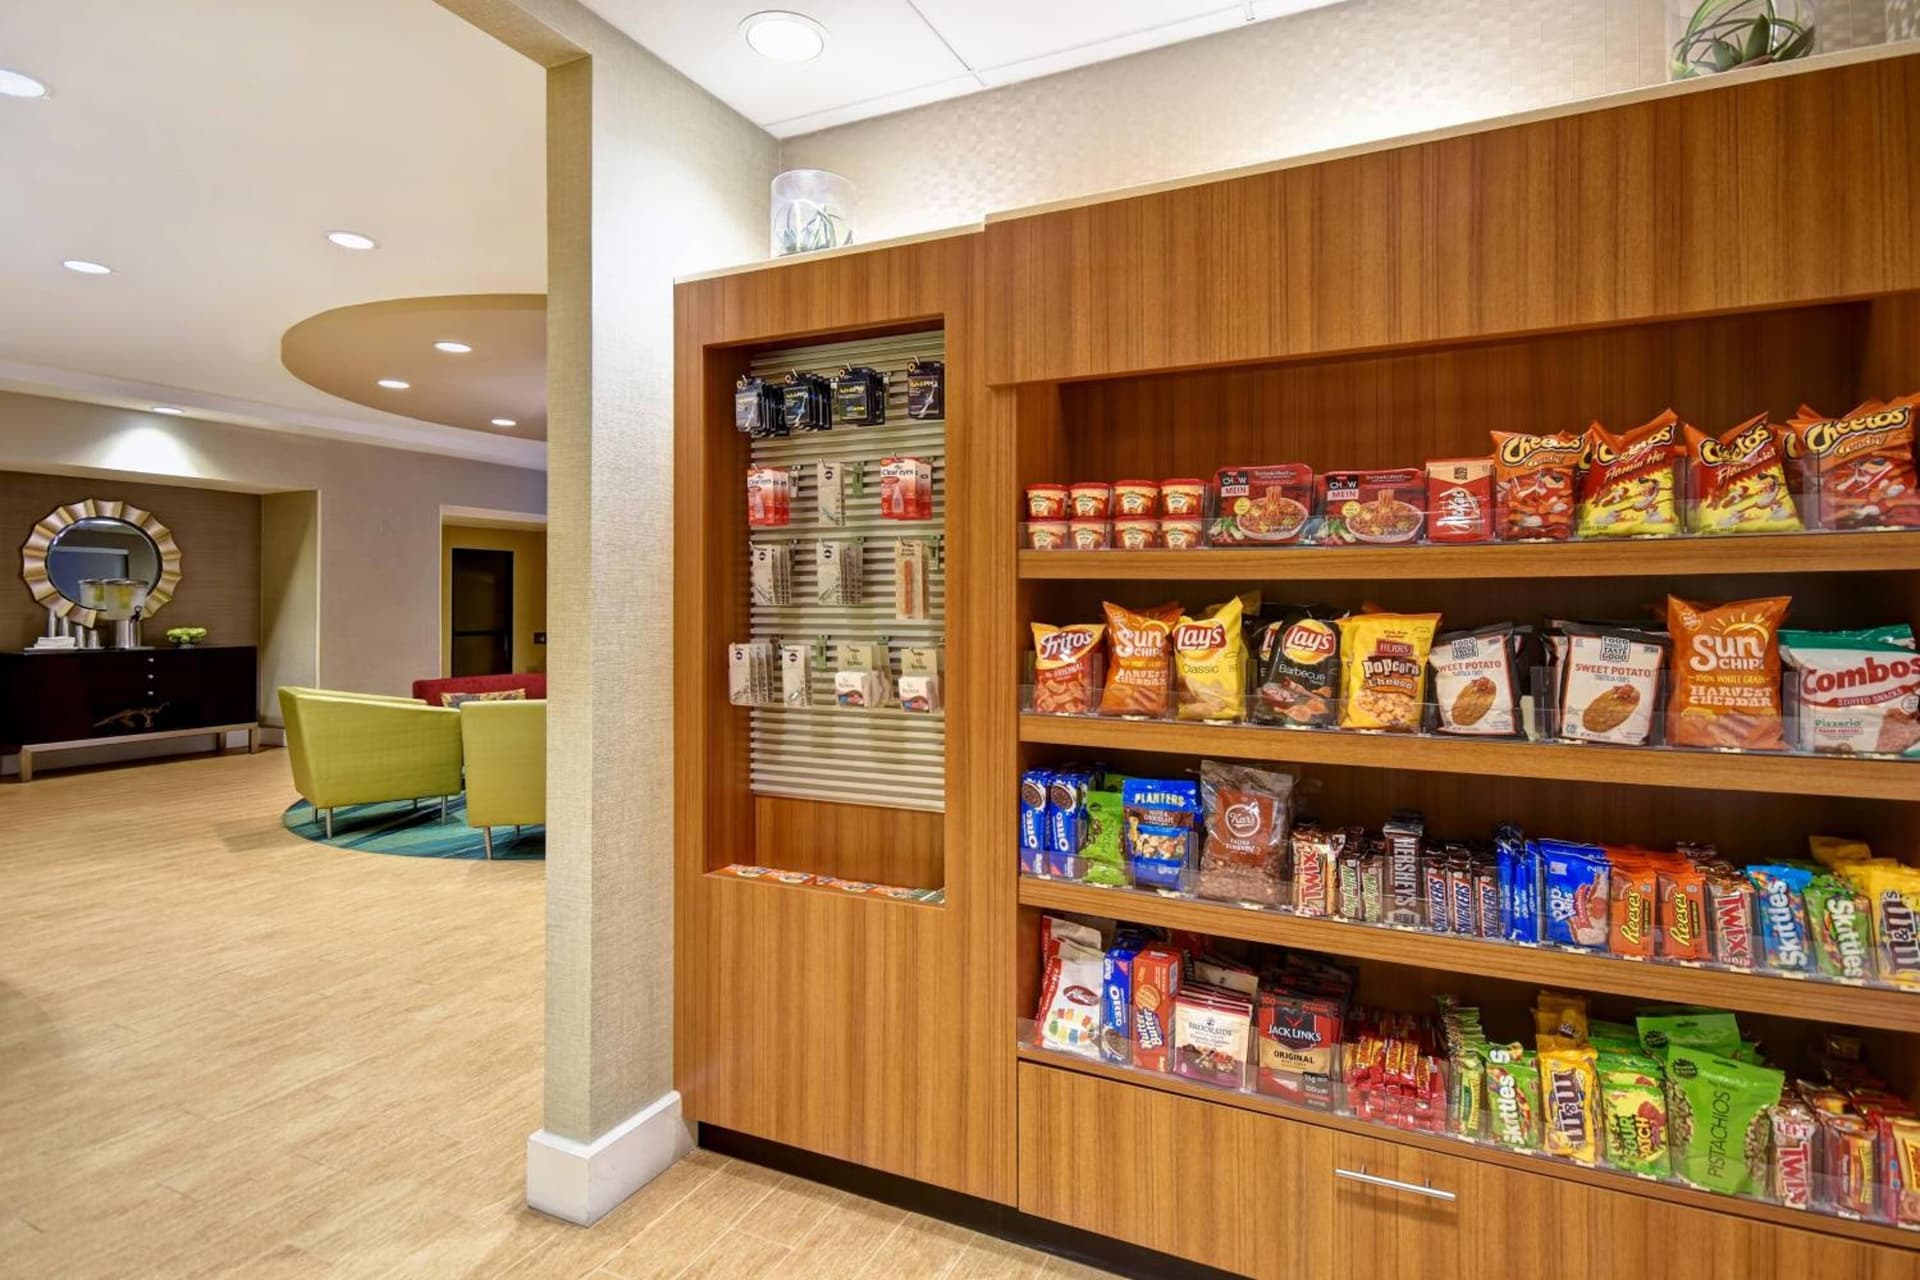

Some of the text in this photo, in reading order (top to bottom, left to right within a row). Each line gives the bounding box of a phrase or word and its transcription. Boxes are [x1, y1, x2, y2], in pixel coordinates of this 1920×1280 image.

[1806, 405, 1910, 458] Cheetos
[1040, 631, 1095, 659] Fritos
[1116, 627, 1164, 657] Sun
[1177, 625, 1222, 651] Lay's
[1285, 626, 1335, 652] Lay's
[1689, 633, 1764, 671] Sun
[1279, 664, 1326, 681] Barbecue
[1439, 660, 1502, 673] WEET POTATO
[1576, 664, 1652, 678] SWEET POTATO
[1802, 656, 1920, 695] Combos
[1689, 696, 1772, 707] CHEDDAR
[1690, 685, 1772, 698] HARVEST
[1135, 793, 1186, 808] PLANTERS
[1302, 852, 1323, 902] TWIX
[1430, 877, 1447, 932] SNICKERS
[1455, 882, 1472, 935] SNICKERS
[1619, 890, 1642, 944] Reese's
[1669, 892, 1690, 946] Reese's
[1768, 881, 1807, 966] Skittles
[1717, 893, 1749, 956] TWIX
[1827, 899, 1863, 978] Skittles
[1268, 1024, 1291, 1038] JACK
[1273, 1050, 1315, 1064] ORIGINAL
[1497, 1075, 1525, 1146] Skittles
[1708, 1089, 1730, 1177] PISTACHIOS
